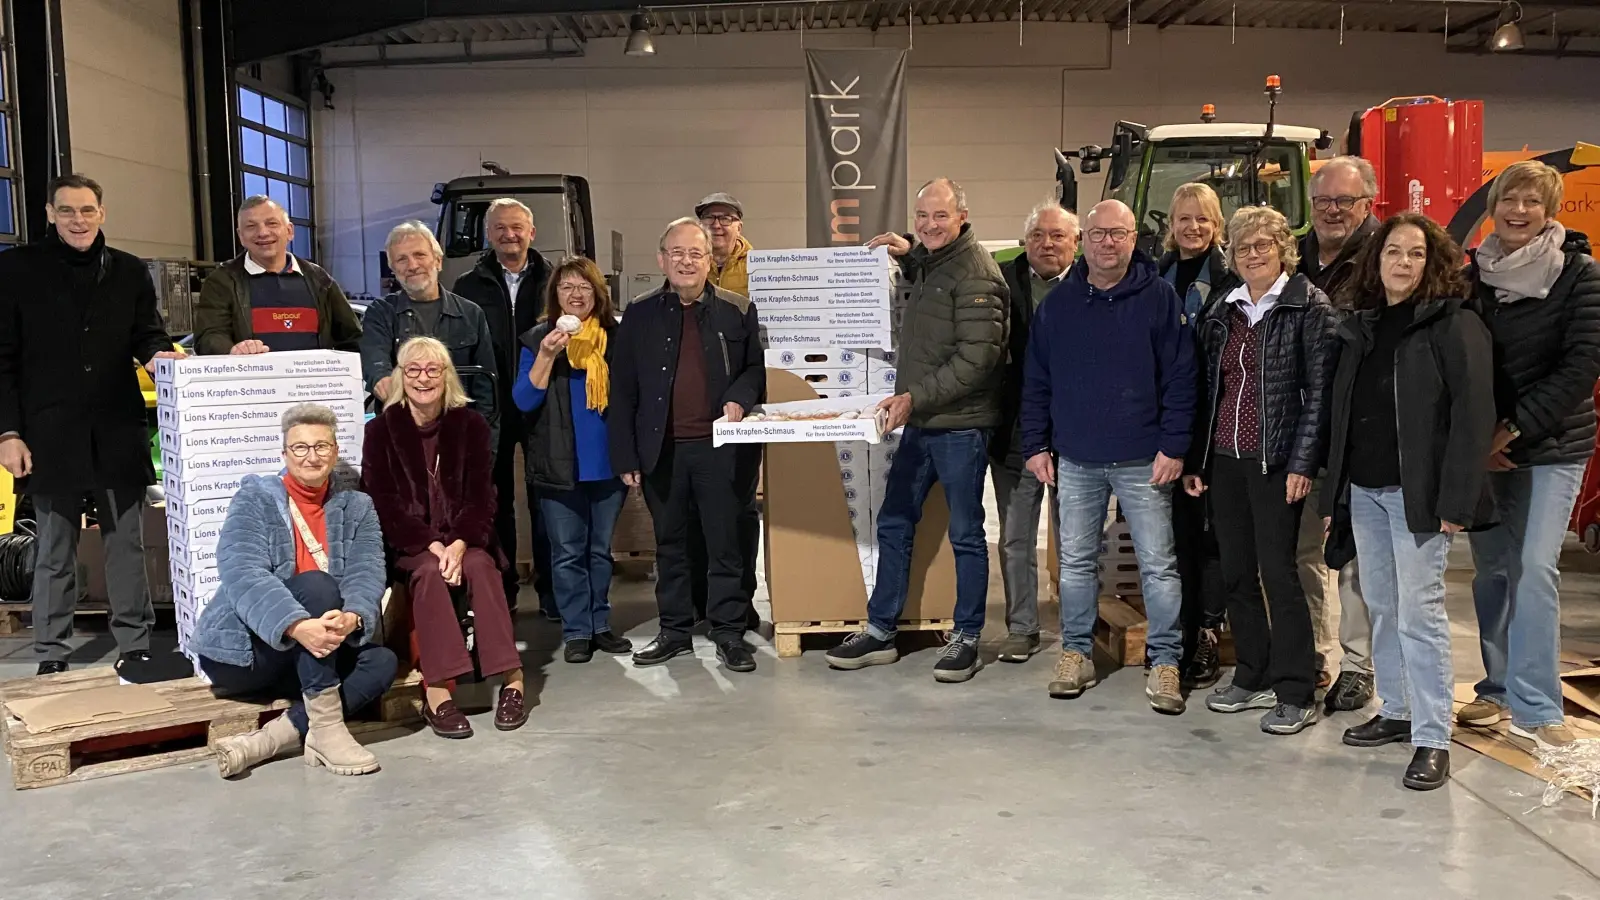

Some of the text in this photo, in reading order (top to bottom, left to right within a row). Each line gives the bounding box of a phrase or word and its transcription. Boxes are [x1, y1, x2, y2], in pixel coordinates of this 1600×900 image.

[767, 254, 818, 263] Krapfen-Schmaus
[768, 274, 819, 283] Krapfen-Schmaus
[769, 295, 820, 303] Krapfen-Schmaus
[770, 315, 820, 323] Krapfen-Schmaus
[770, 335, 820, 344] Krapfen-Schmaus
[179, 364, 273, 374] Lions Krapfen-Schmaus
[207, 388, 276, 398] Krapfen-Schmaus
[184, 411, 278, 422] Lions Krapfen-Schmaus
[736, 427, 795, 436] Krapfen-Schmaus
[186, 434, 280, 446] Lions Krapfen-Schmaus
[212, 456, 281, 468] Krapfen-Schmaus
[193, 507, 214, 515] Lions
[195, 530, 216, 538] Lions
[34, 760, 66, 773] EPAL
